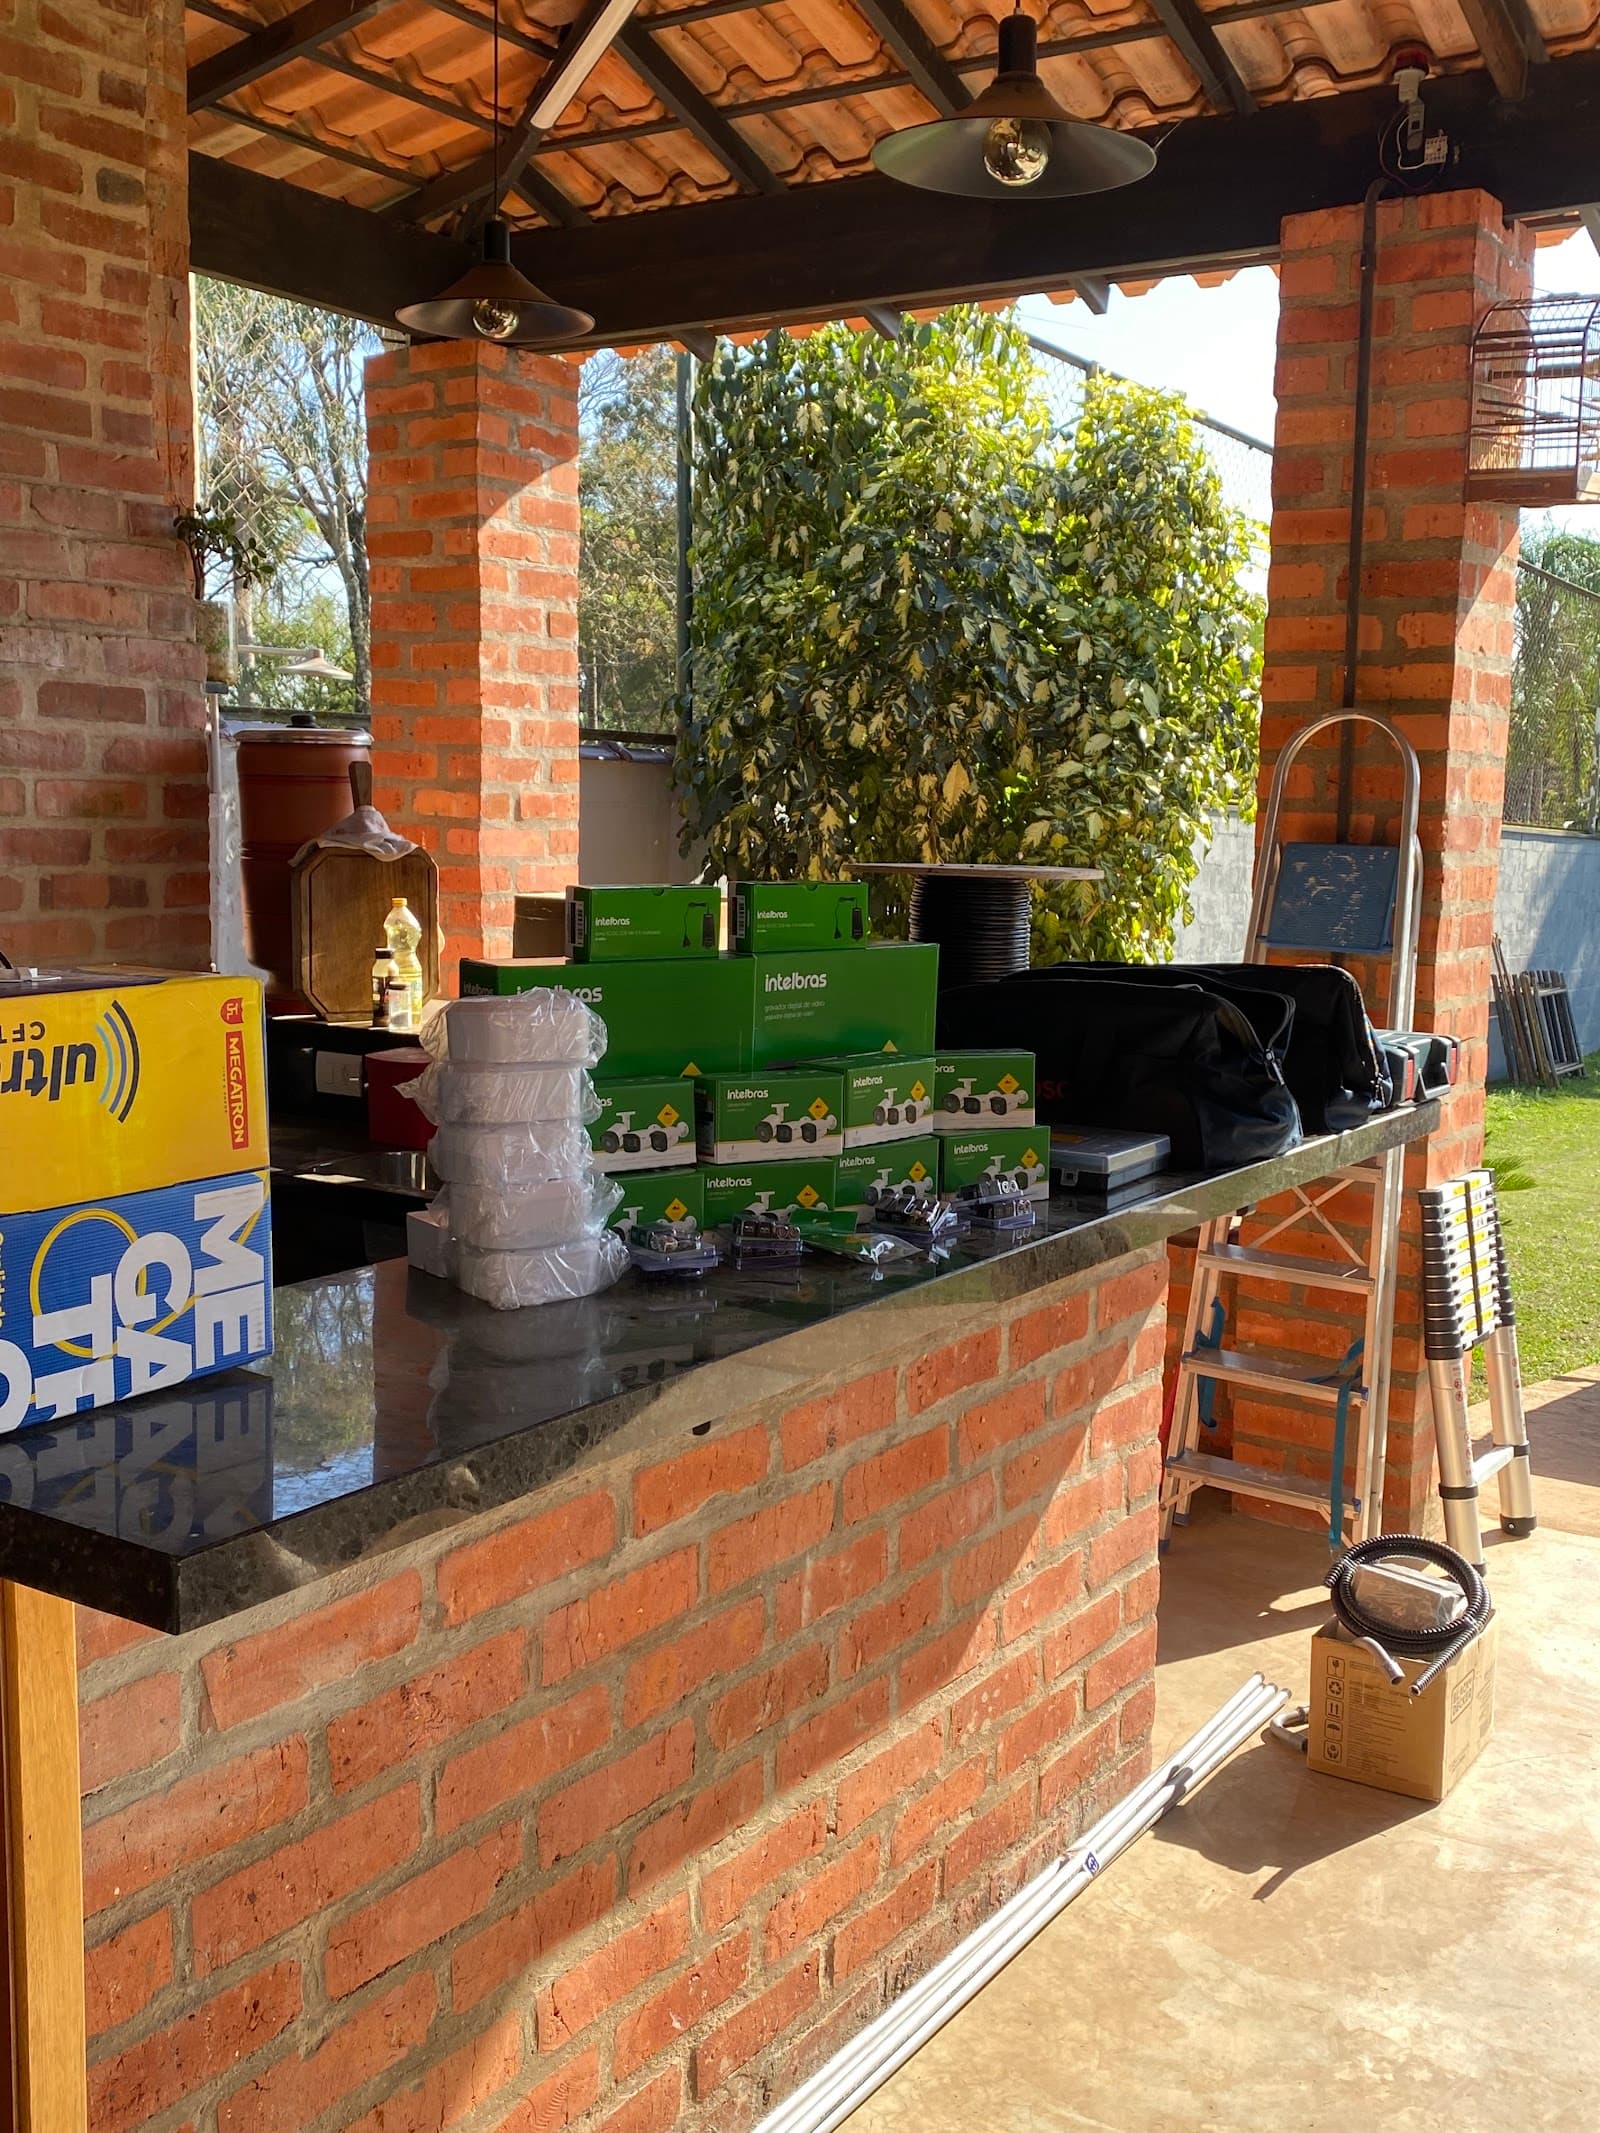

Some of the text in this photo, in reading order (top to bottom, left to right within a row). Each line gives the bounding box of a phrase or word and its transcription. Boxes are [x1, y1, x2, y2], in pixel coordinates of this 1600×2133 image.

[756, 909, 789, 919] intelbras
[594, 916, 631, 926] intelbras
[764, 971, 828, 993] intelbras
[852, 1076, 883, 1088] intelbras
[229, 1037, 245, 1143] MEGATRON
[727, 1088, 769, 1100] intelbras
[953, 1143, 989, 1155] intelbras
[839, 1156, 876, 1168] intelbras
[706, 1176, 752, 1189] intelbras
[194, 1181, 267, 1370] ME
[114, 1231, 193, 1400] GA
